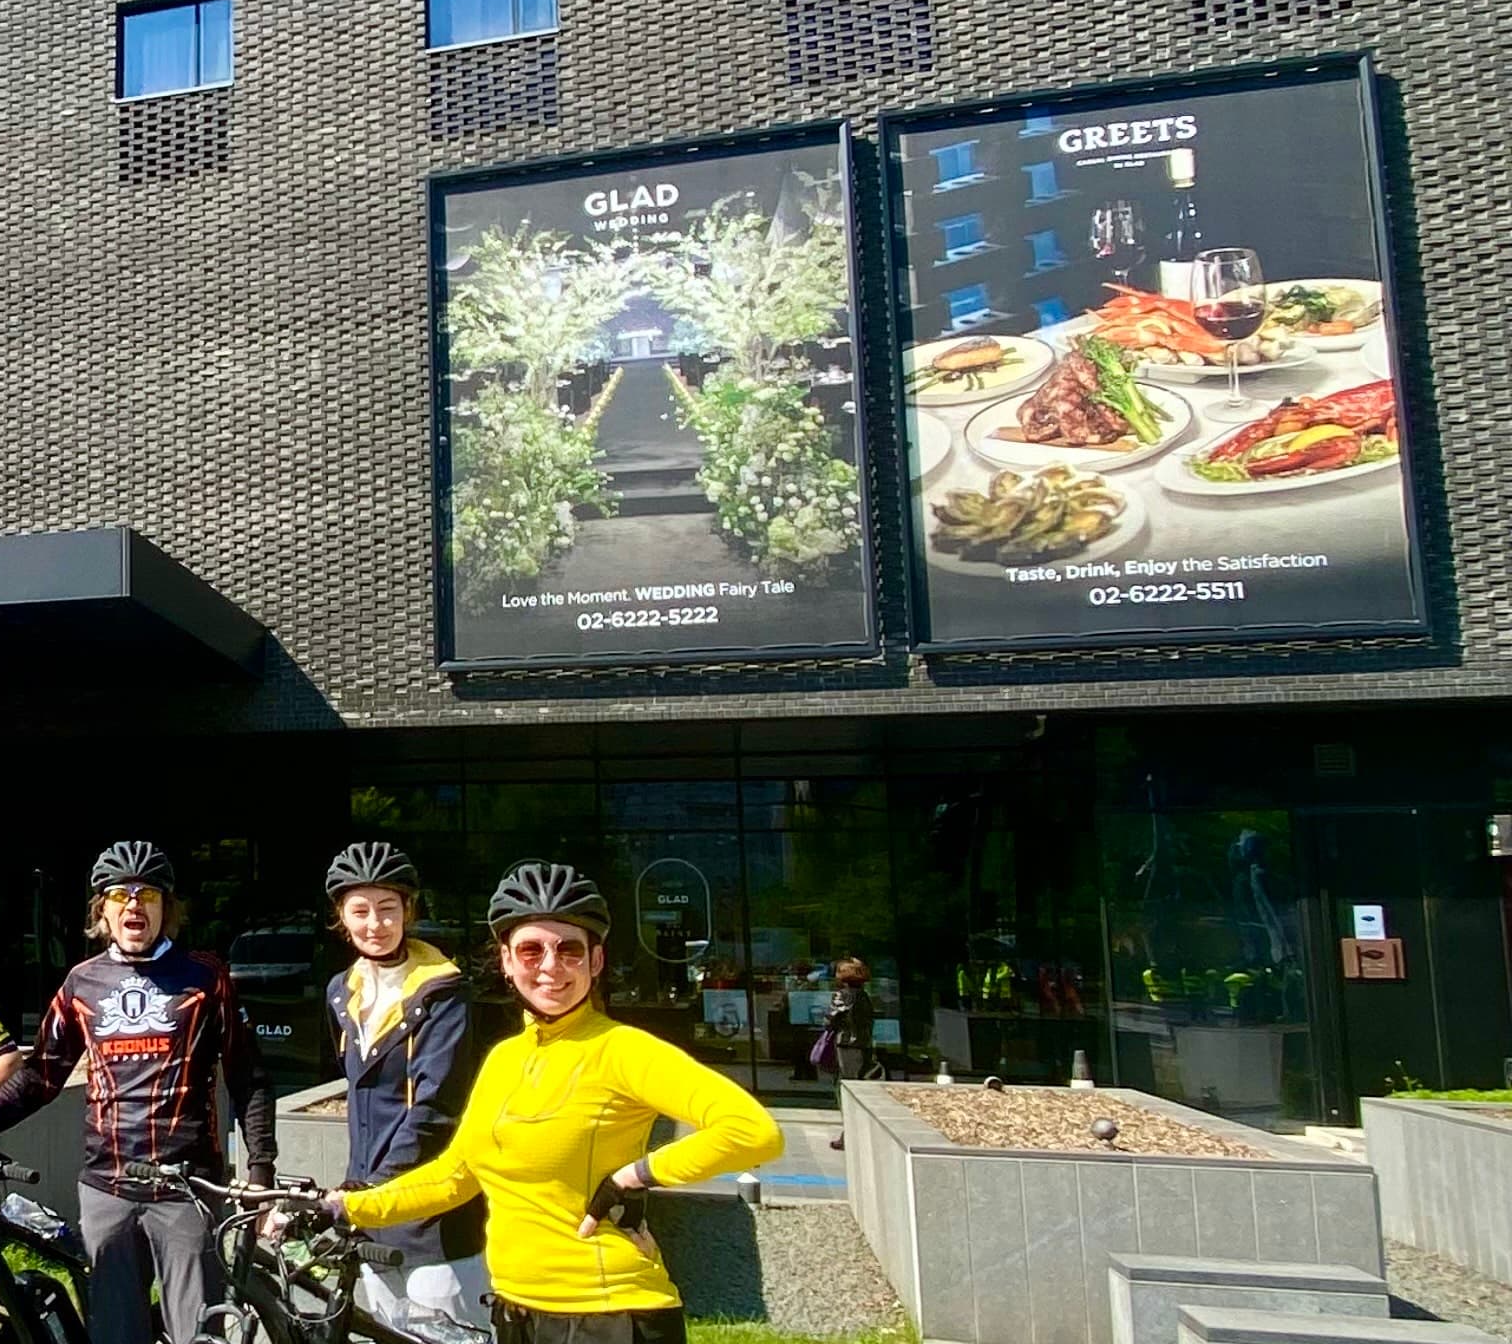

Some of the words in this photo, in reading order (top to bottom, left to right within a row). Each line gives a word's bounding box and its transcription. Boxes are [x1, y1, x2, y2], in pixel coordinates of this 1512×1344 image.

[1059, 115, 1197, 153] GREETS
[584, 183, 680, 216] GLAD
[594, 213, 669, 232] WEDDING
[1006, 567, 1062, 583] Taste,
[1066, 564, 1121, 579] Drink,
[1125, 559, 1177, 576] Enjoy
[1182, 557, 1214, 573] the
[1217, 553, 1328, 572] Satisfaction
[502, 594, 538, 608] Love
[541, 592, 564, 606] the
[635, 583, 716, 602] WEDDING
[719, 582, 757, 599] Fairy
[760, 579, 795, 595] Tale
[1089, 581, 1245, 605] 02-6222-5511
[576, 607, 719, 630] 02-6222-5222
[657, 895, 689, 904] GLAD
[256, 1024, 292, 1036] GLAD
